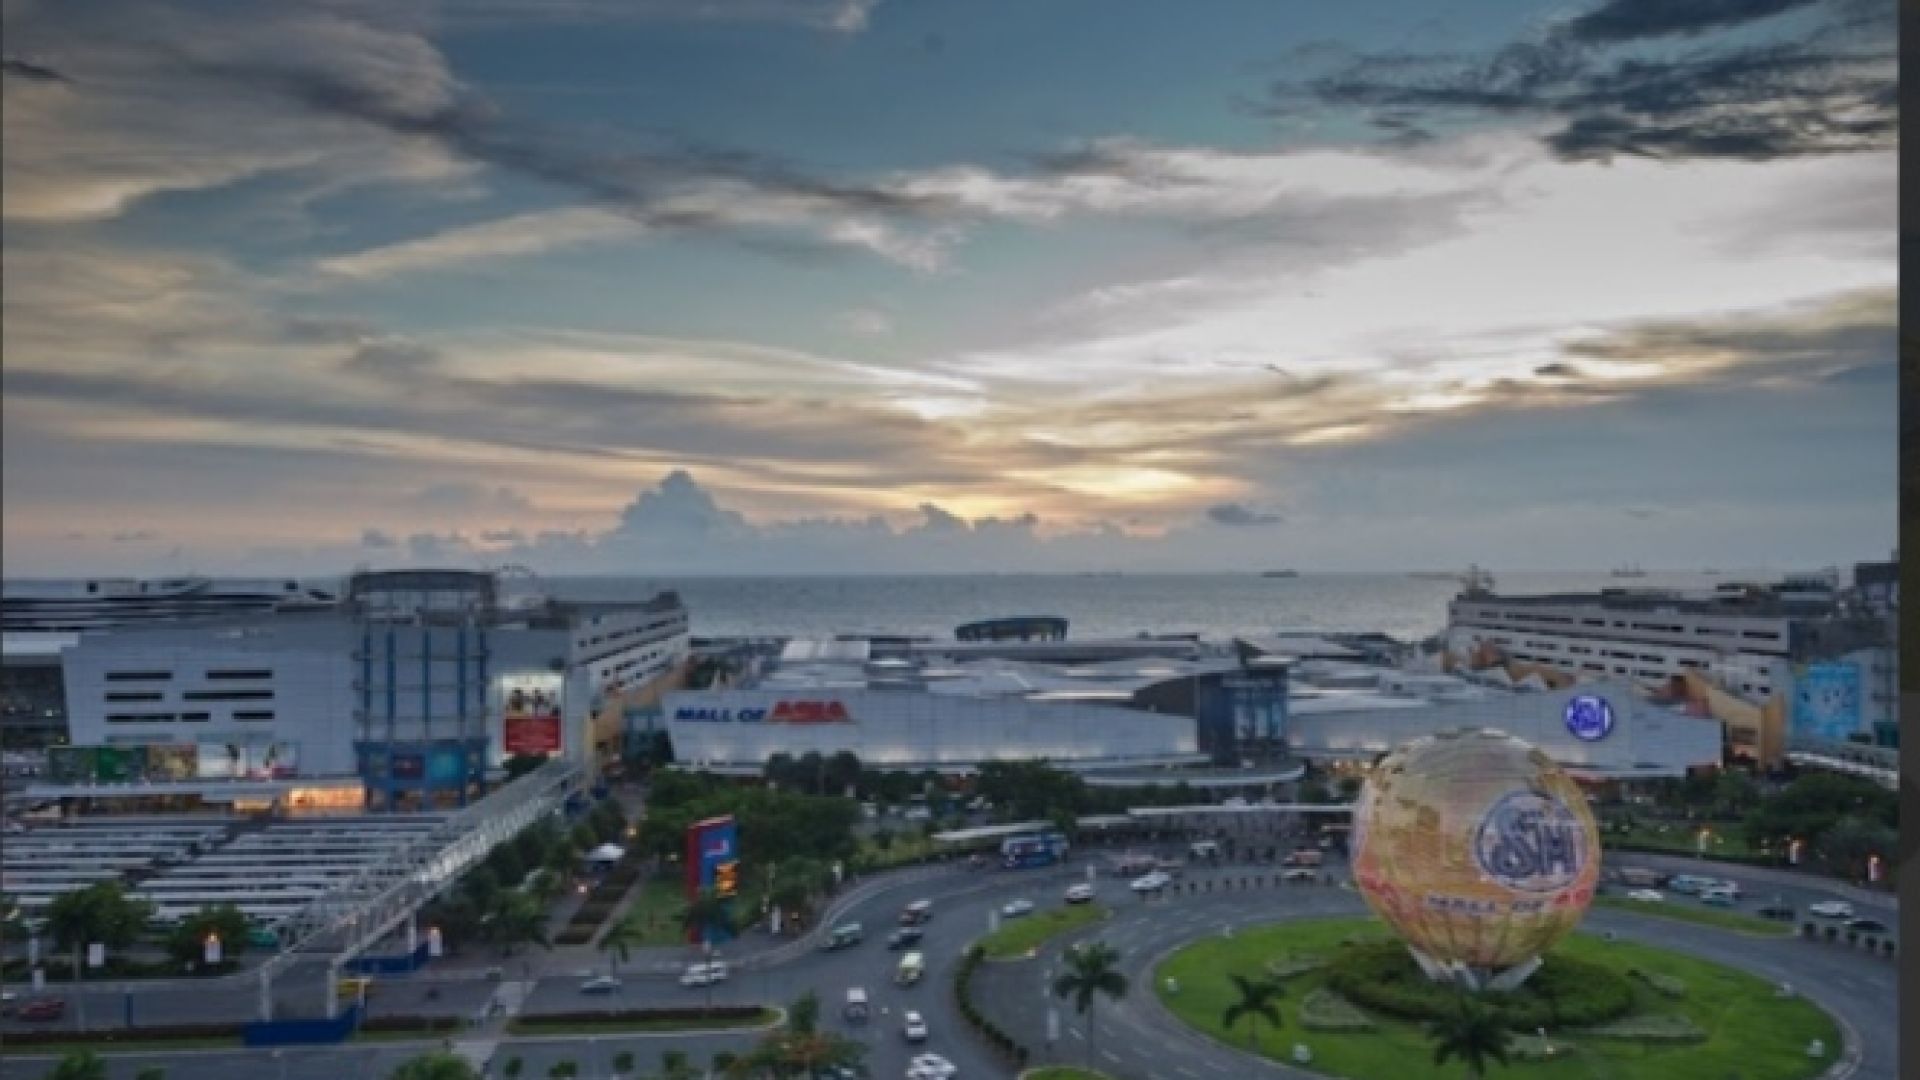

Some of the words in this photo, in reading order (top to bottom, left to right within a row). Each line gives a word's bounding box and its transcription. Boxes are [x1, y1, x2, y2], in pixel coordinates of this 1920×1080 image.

[676, 707, 730, 721] MALL
[737, 707, 767, 721] OF
[767, 699, 851, 723] ASIA
[1426, 894, 1496, 914] MALL
